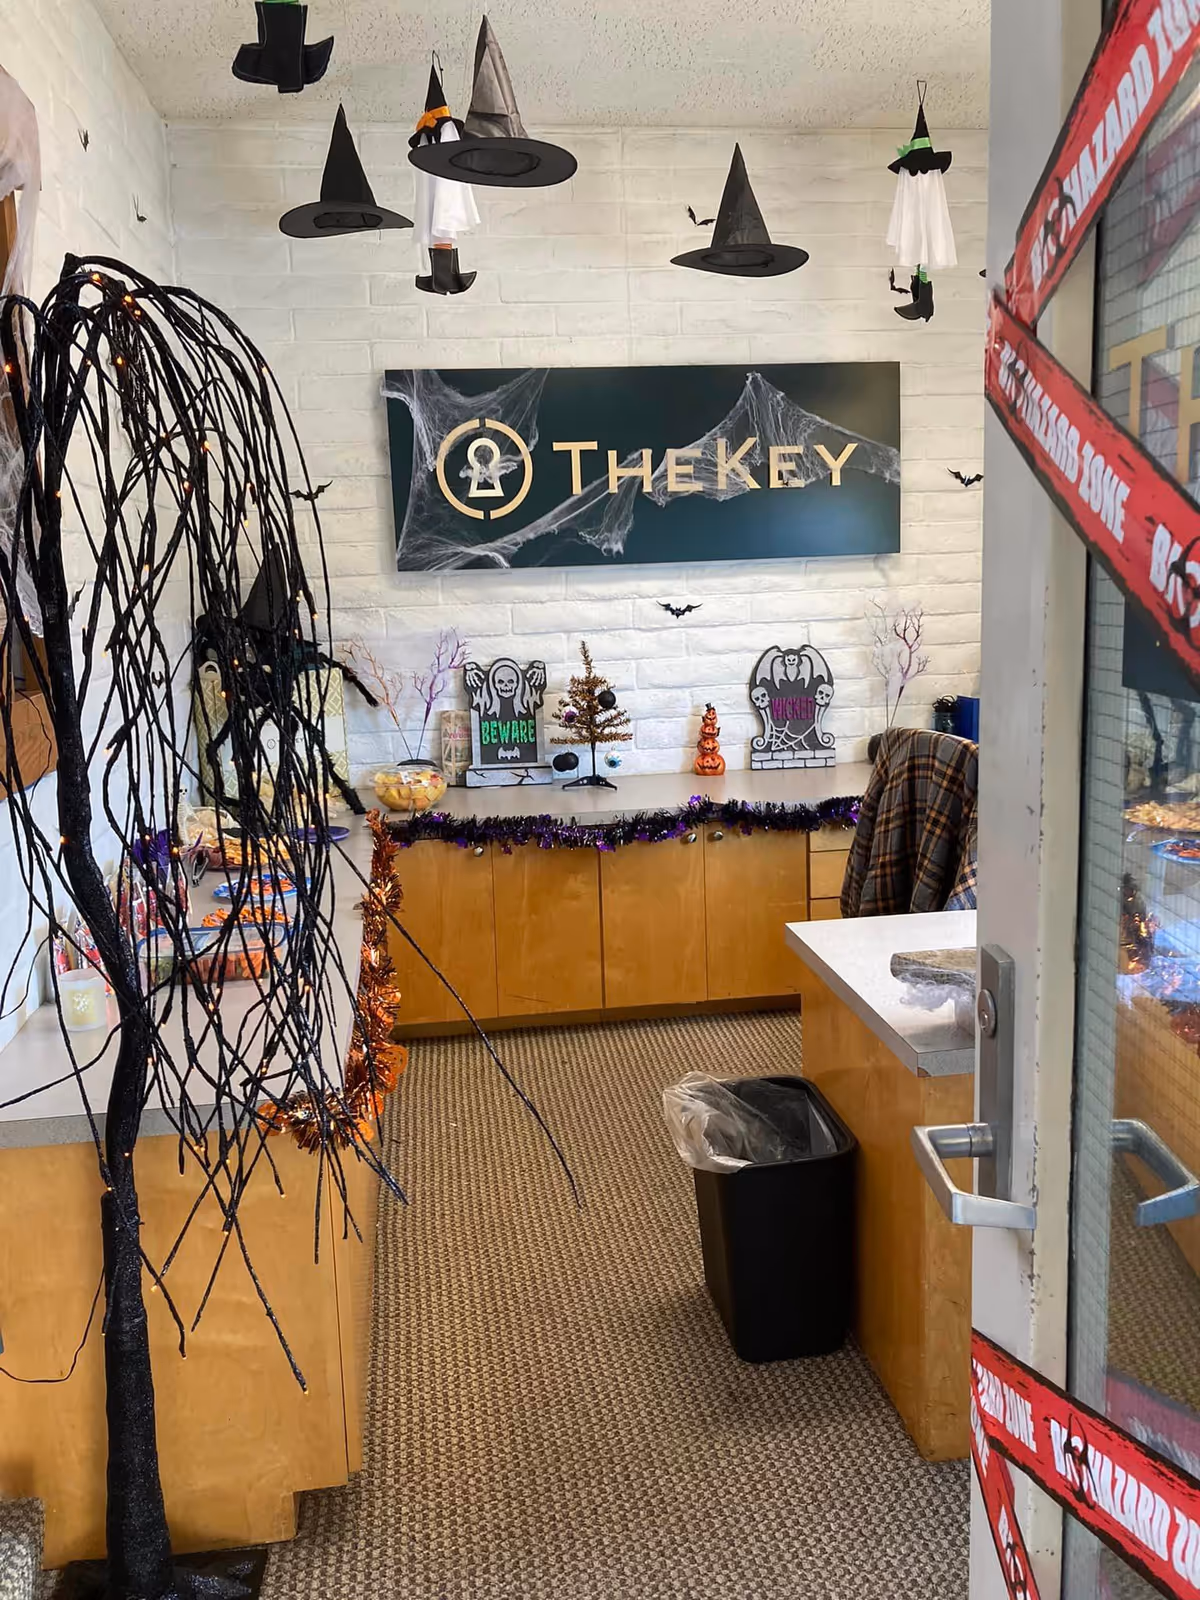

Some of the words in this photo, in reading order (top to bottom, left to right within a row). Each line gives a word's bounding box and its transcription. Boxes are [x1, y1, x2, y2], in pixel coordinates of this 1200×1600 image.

[1079, 440, 1131, 544] ZONE
[481, 719, 536, 746] BEWARE
[771, 697, 815, 721] WICKED
[1003, 1382, 1037, 1453] ZONE
